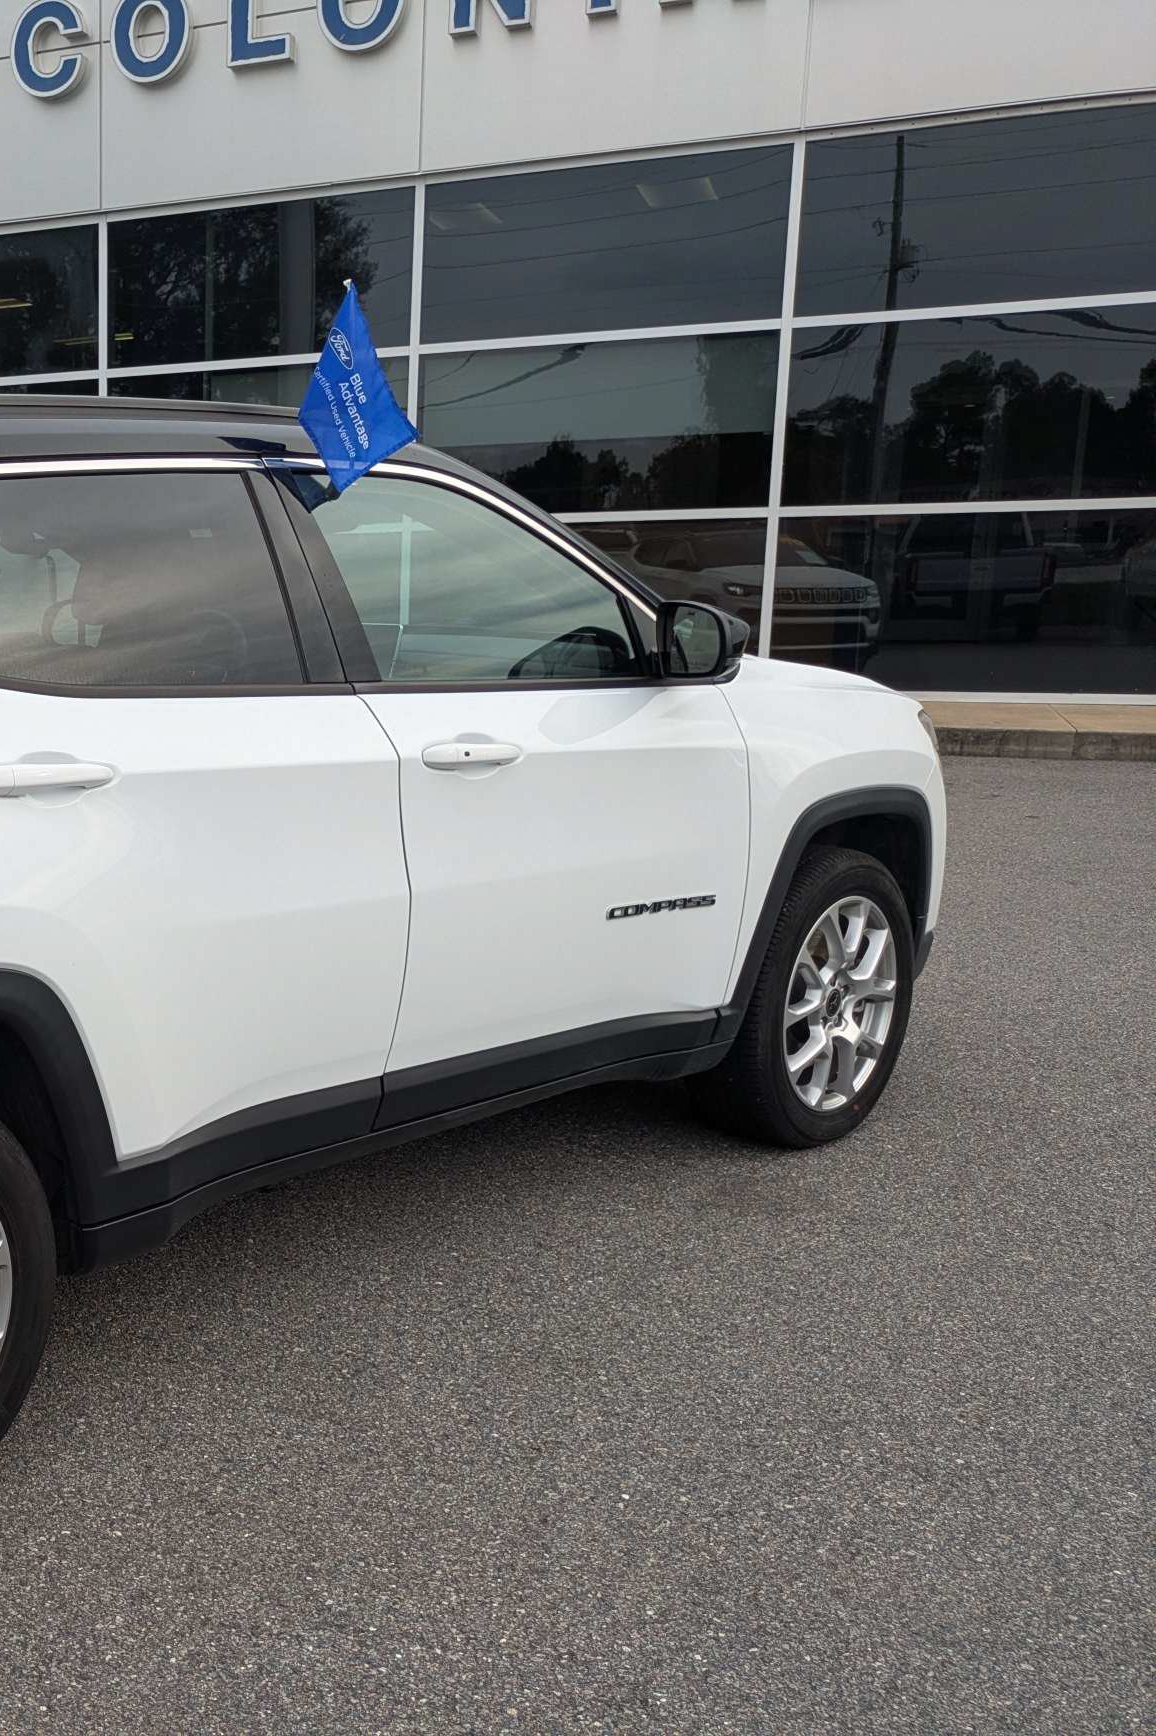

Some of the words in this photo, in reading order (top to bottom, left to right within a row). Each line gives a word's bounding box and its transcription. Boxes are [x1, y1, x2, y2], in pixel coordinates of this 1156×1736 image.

[330, 334, 351, 361] Ford
[349, 373, 367, 405] Blue
[313, 366, 335, 401] Certified
[330, 401, 342, 425] Used
[338, 425, 356, 458] Vehicle
[339, 382, 370, 450] Advantage
[606, 894, 717, 920] COMPASS
